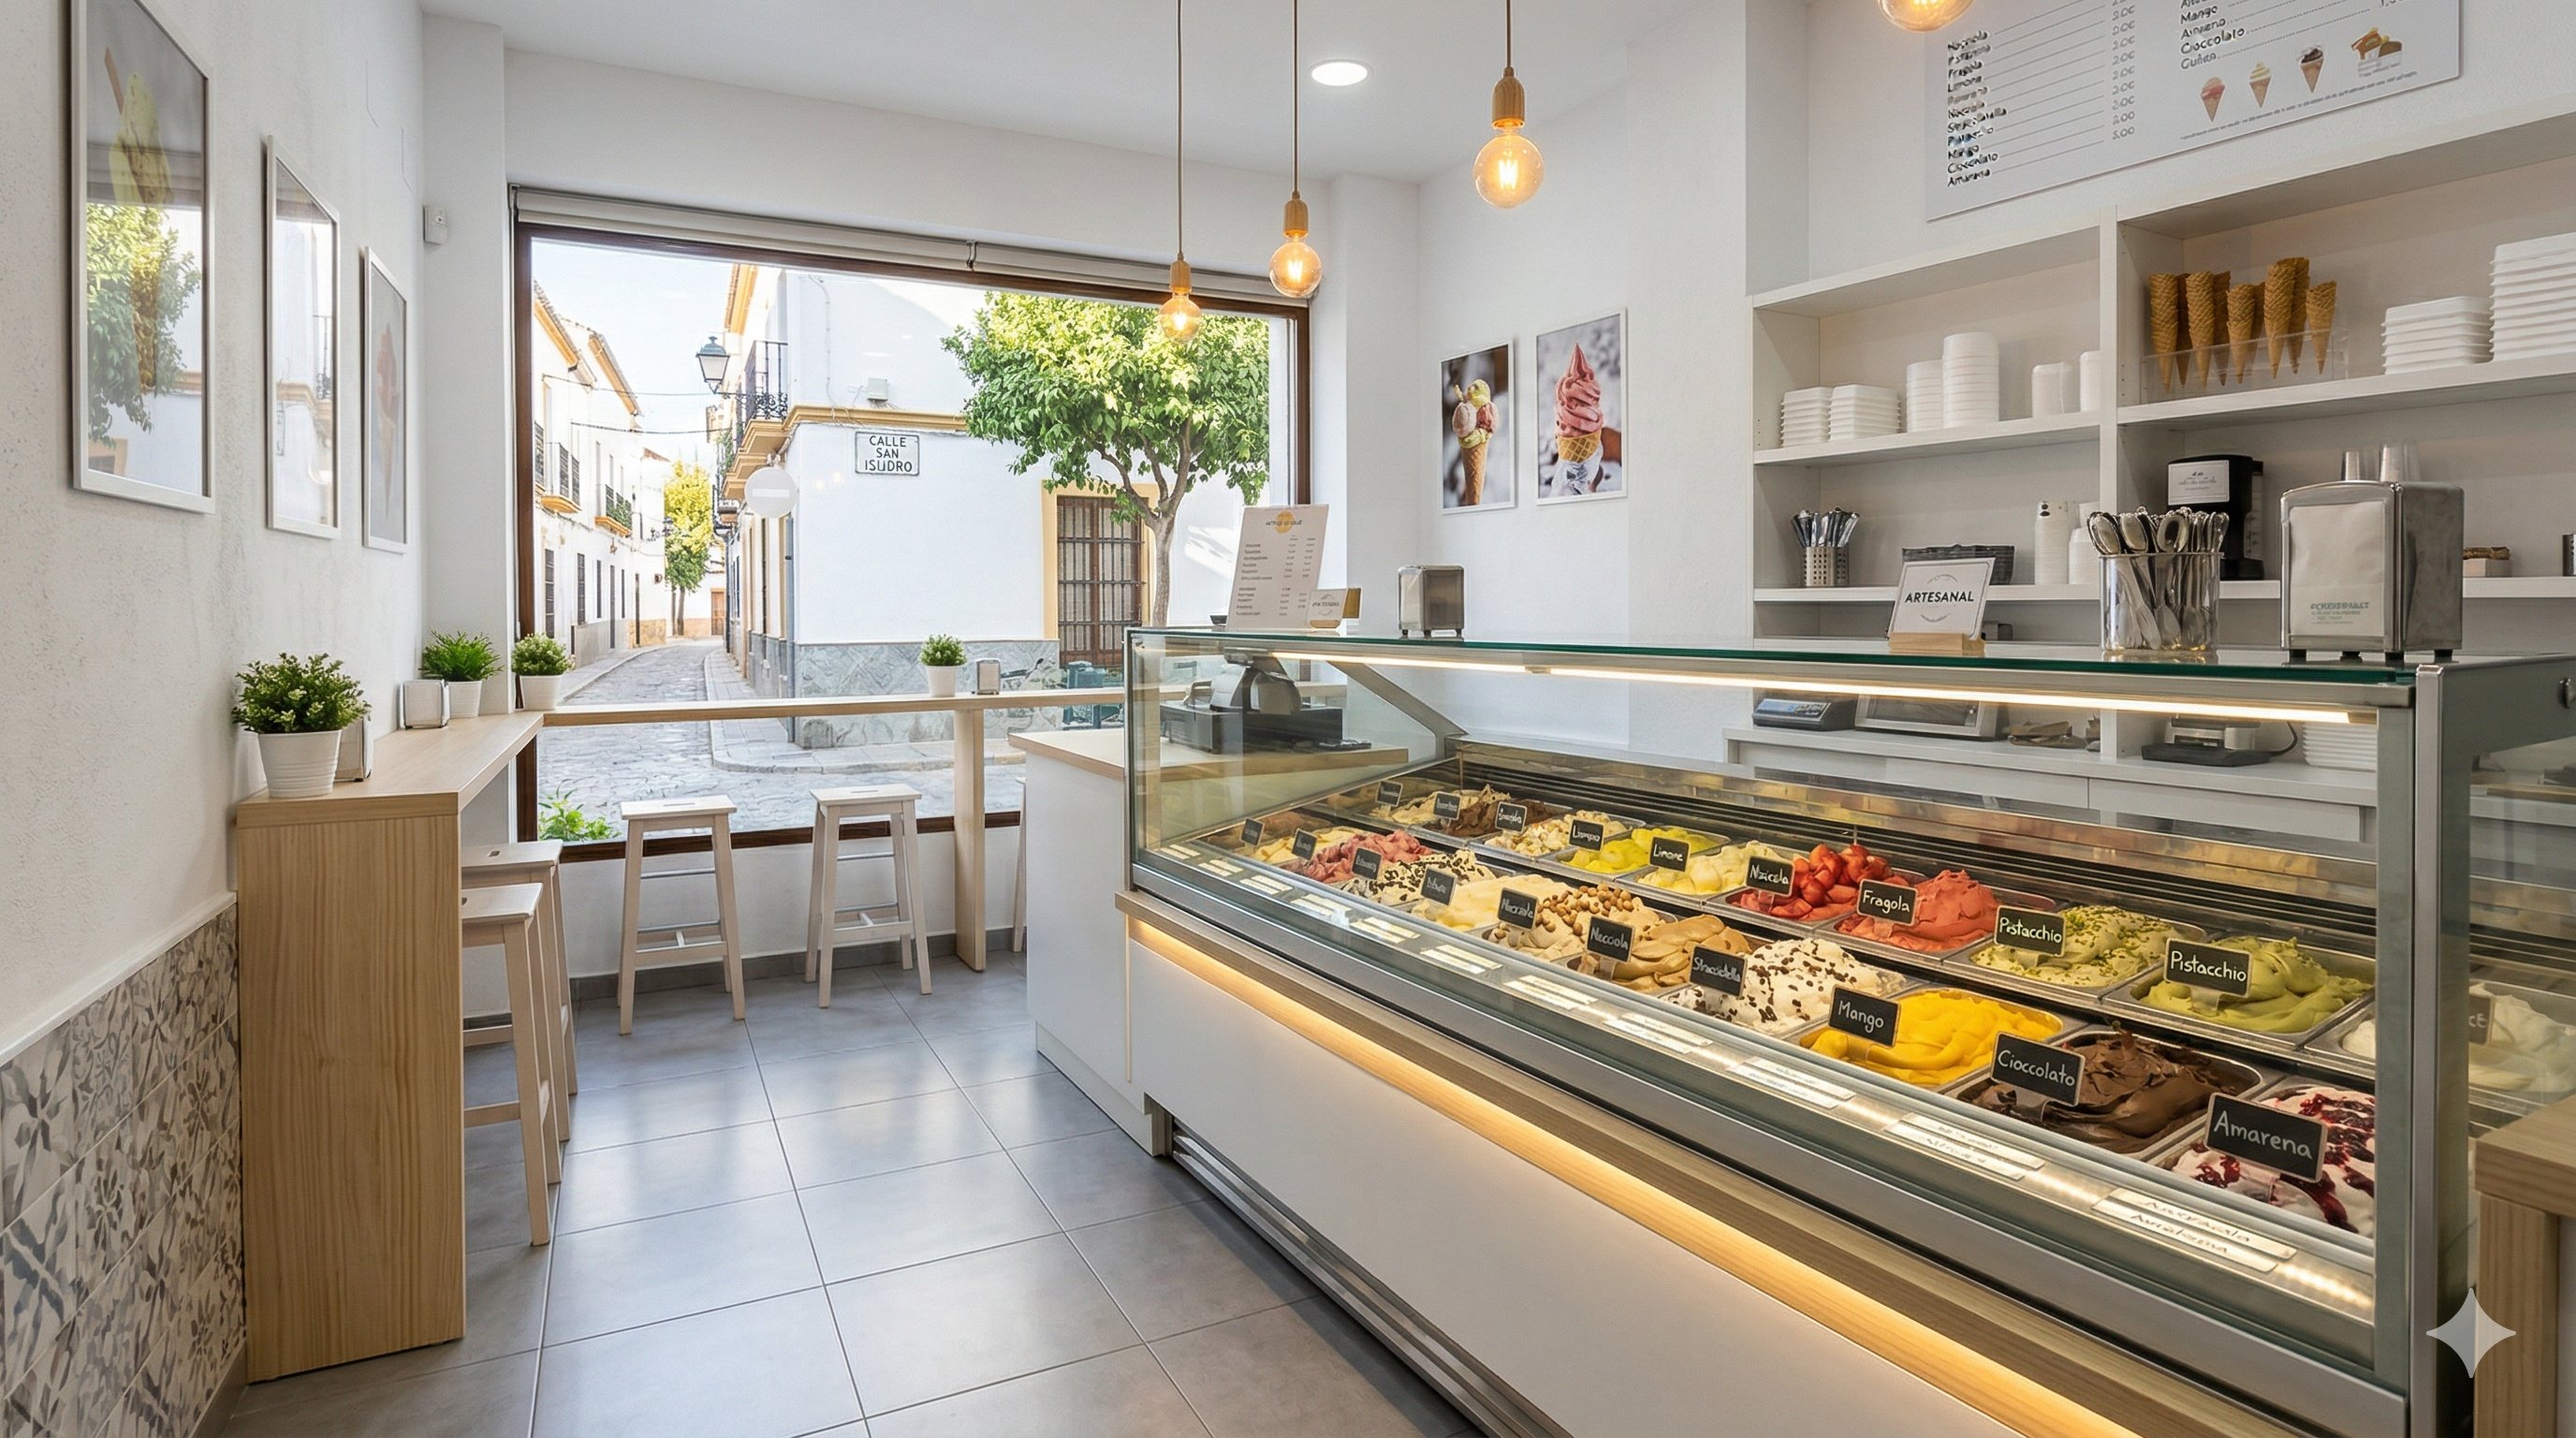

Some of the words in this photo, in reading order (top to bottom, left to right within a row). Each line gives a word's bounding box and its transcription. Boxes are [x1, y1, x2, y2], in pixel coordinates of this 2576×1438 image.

[869, 435, 907, 448] CALLE
[875, 448, 899, 459] SAN
[1905, 591, 1974, 603] ARTESANAL
[1863, 889, 1910, 914] Fragola
[2170, 950, 2247, 982] Pistacchio
[1837, 1000, 1884, 1034] Mango
[1998, 1049, 2076, 1087] Cioccolato
[2213, 1110, 2313, 1159] Amarena
